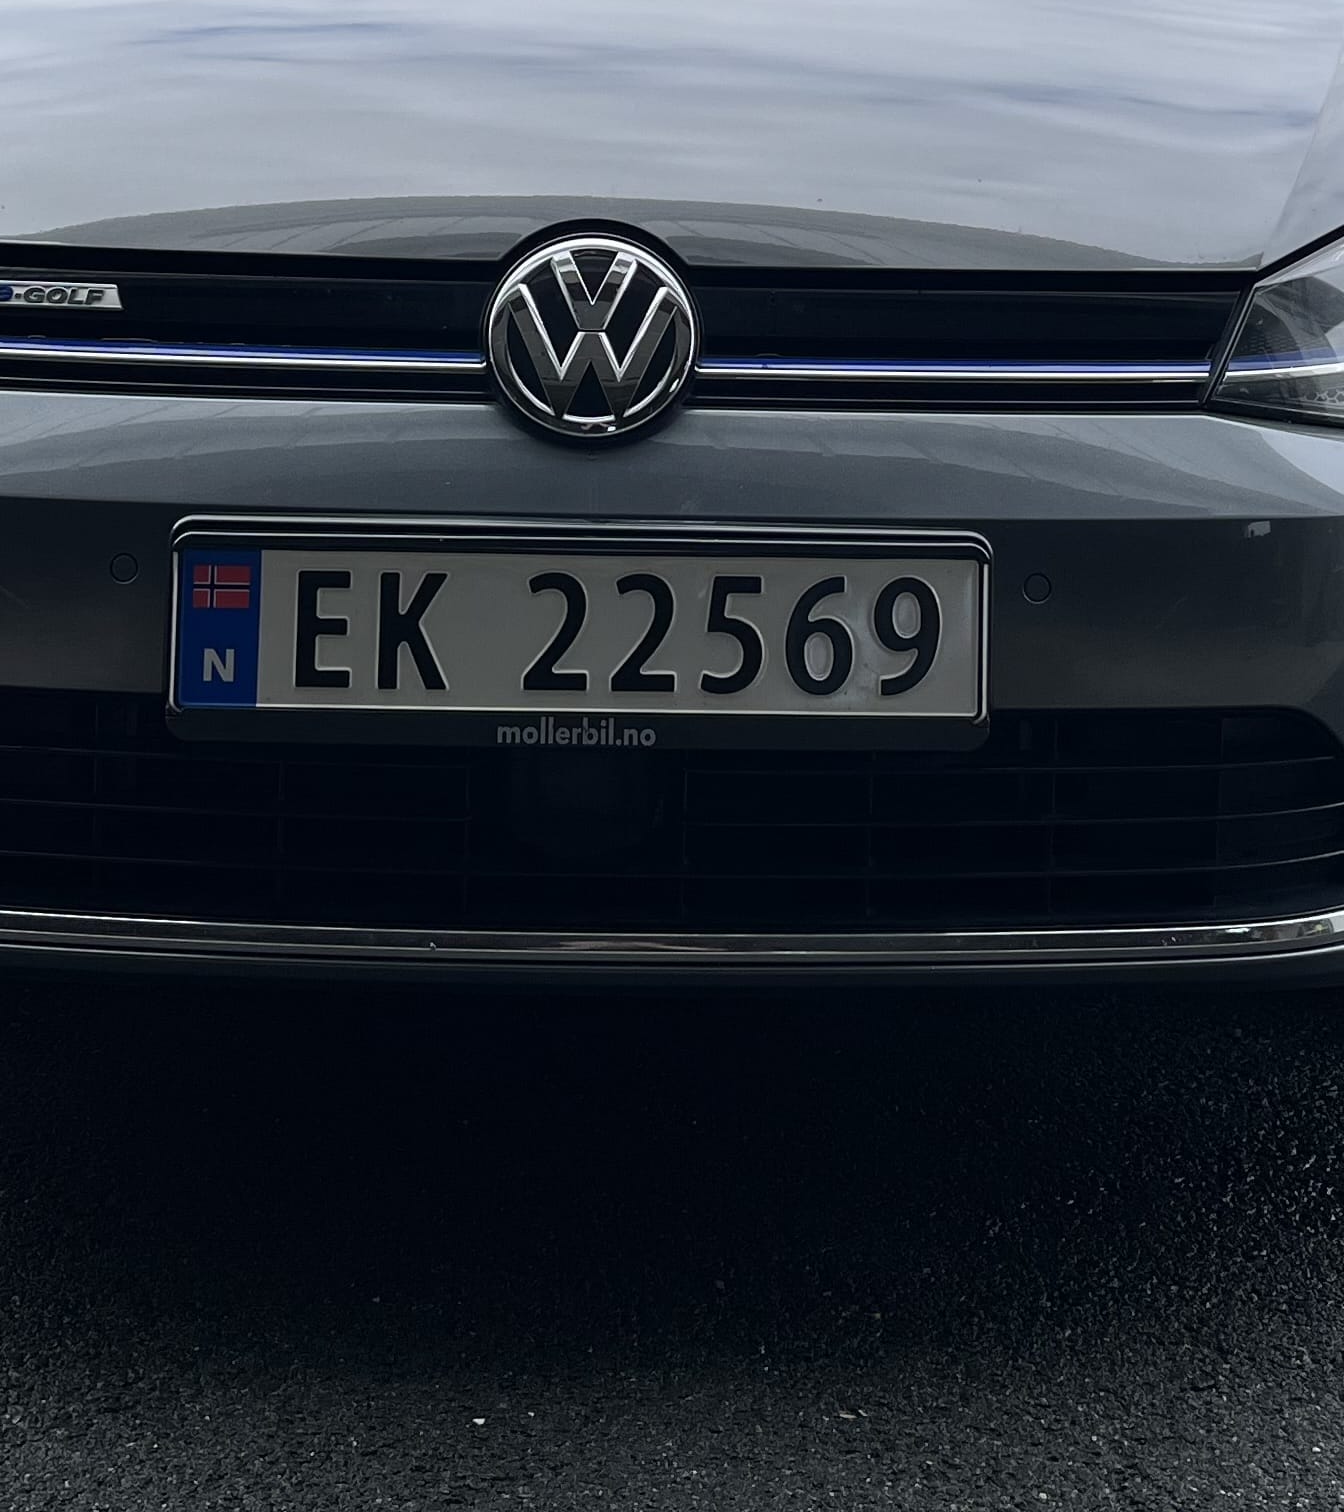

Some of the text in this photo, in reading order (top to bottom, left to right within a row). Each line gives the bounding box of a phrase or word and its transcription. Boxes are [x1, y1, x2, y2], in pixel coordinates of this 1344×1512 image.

[292, 569, 942, 698] EK 22569
[202, 648, 236, 683] N
[496, 716, 657, 746] mollerbil.no
